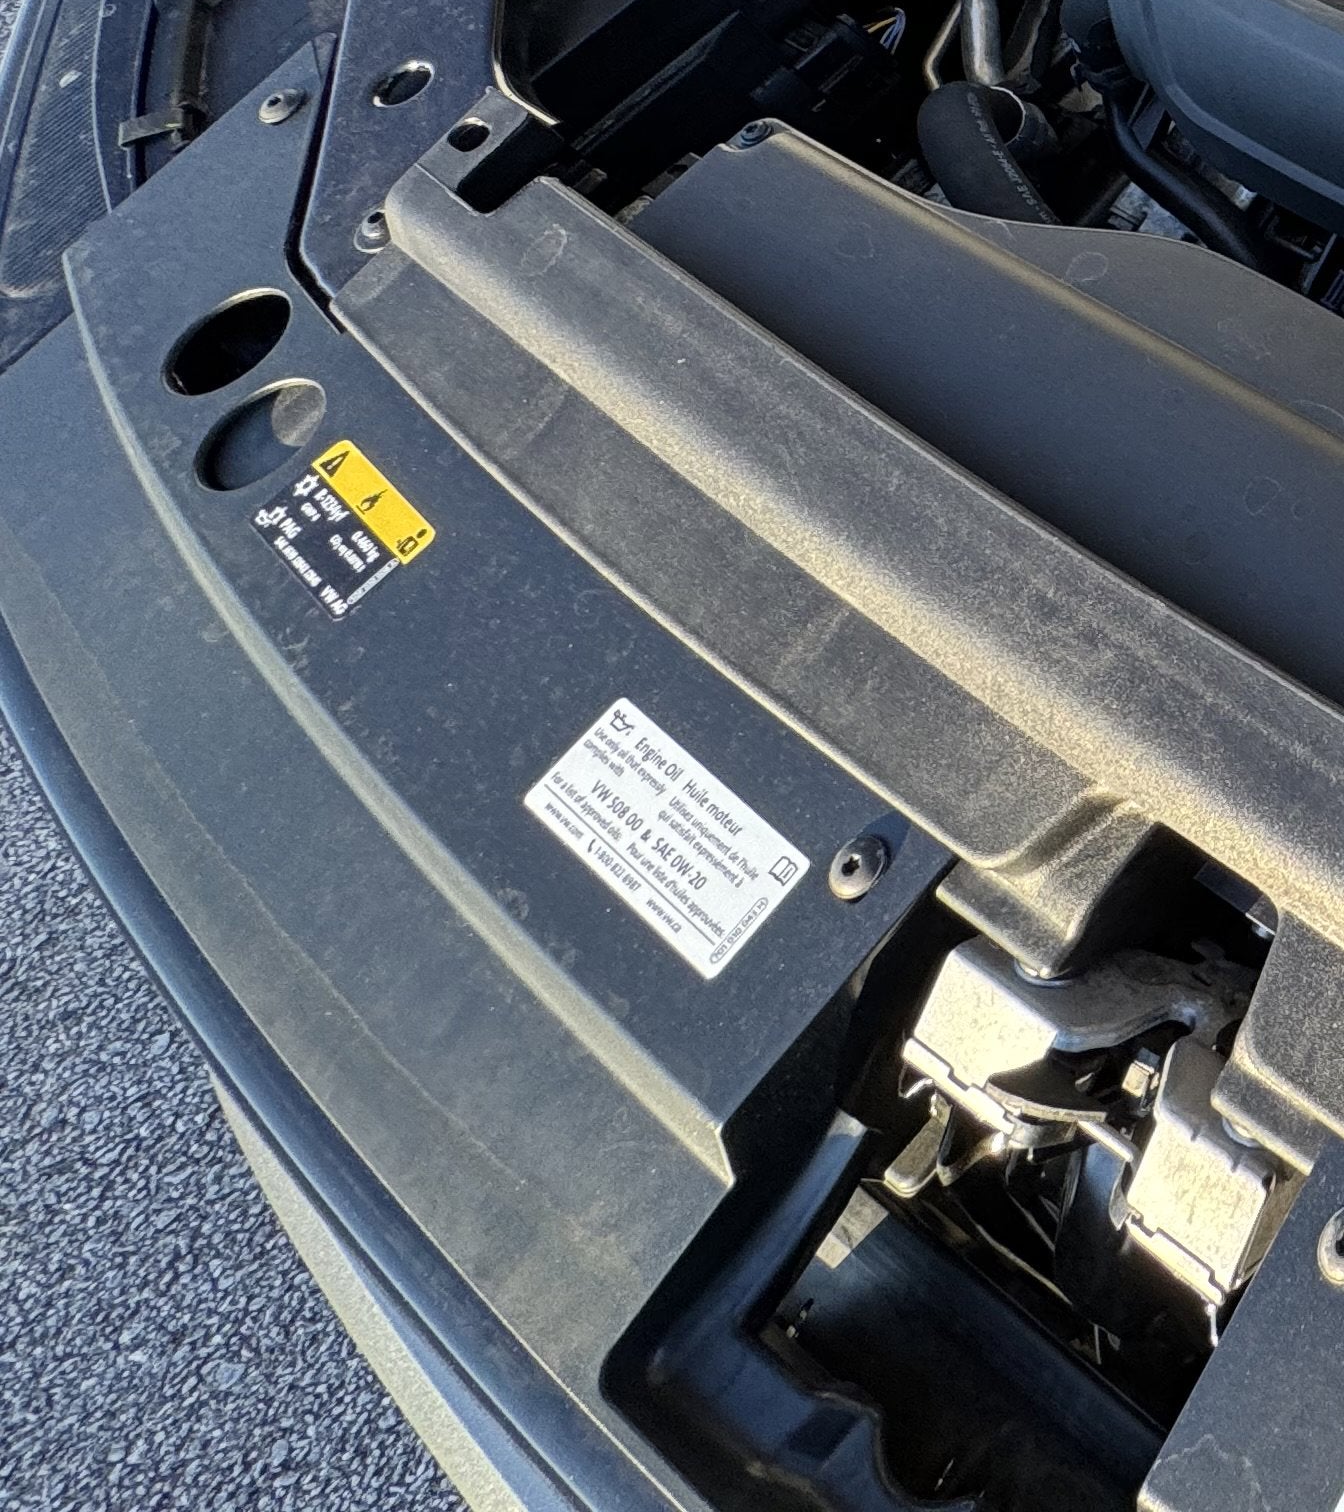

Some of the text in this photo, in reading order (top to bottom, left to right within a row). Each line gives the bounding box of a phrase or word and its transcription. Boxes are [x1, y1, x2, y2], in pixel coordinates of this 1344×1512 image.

[279, 518, 301, 538] PAG
[320, 586, 338, 603] VW
[331, 599, 347, 614] AG
[551, 772, 564, 784] For
[582, 739, 624, 776] complies with
[594, 727, 666, 796] Use only oil that expressly
[565, 785, 578, 798] list
[574, 794, 585, 805] of
[632, 736, 743, 836] Engine Oil Huile moteur
[579, 800, 610, 829] approved
[589, 780, 707, 891] VW 508 00 & SAE 0W-20
[668, 797, 759, 880] Utilisez uniquement de l'huile
[543, 802, 584, 839] www.vw.com
[645, 898, 682, 932] www.vw.ca
[626, 842, 644, 860] Pour
[640, 857, 654, 871] une
[651, 866, 668, 883] liste
[664, 878, 691, 904] d'huiles
[656, 809, 744, 888] qui satisfait expressément à
